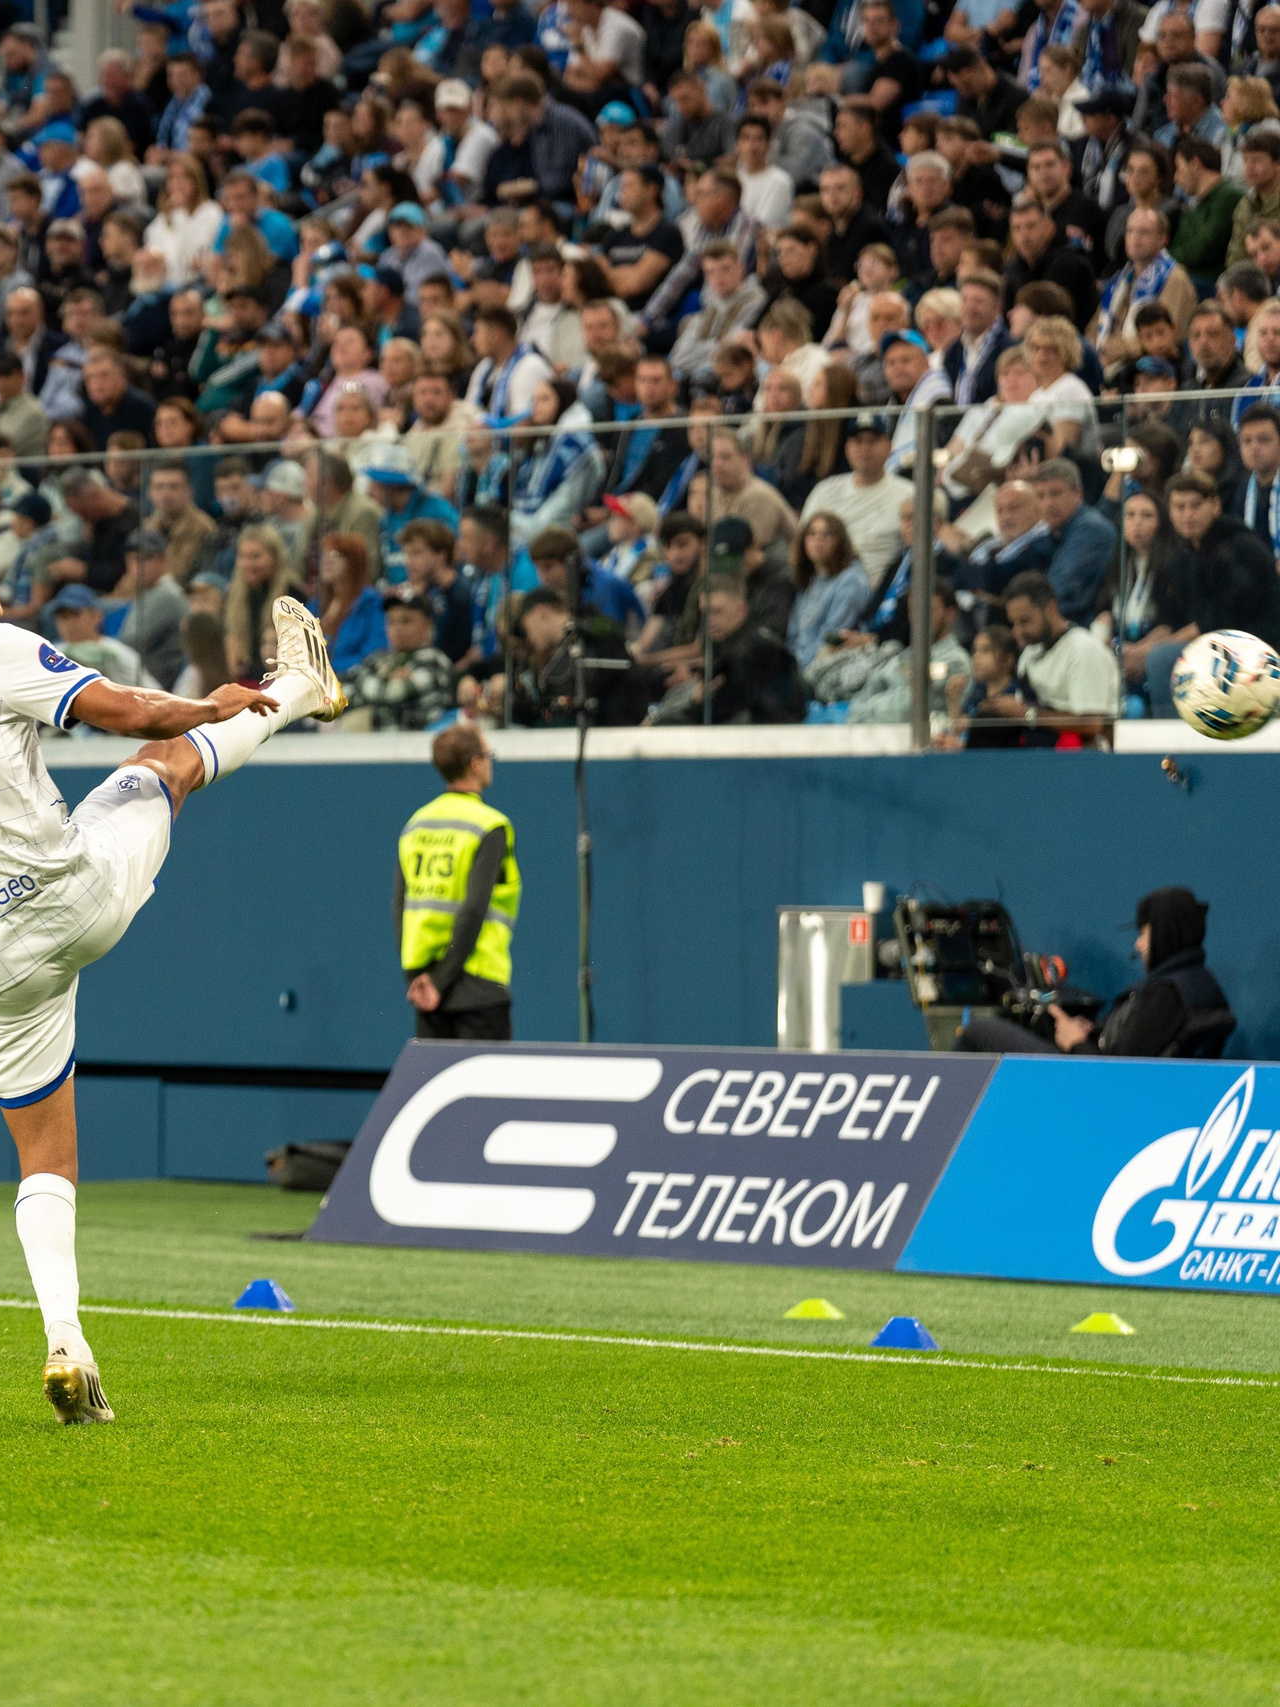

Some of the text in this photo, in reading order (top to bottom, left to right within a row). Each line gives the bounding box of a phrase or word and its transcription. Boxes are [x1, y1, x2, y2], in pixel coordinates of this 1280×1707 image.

[663, 1068, 941, 1142] СЕВЕРЕН
[1217, 1128, 1280, 1201] ГА
[612, 1170, 910, 1250] ТЕЛЕКОМ
[1210, 1211, 1280, 1239] ТРА
